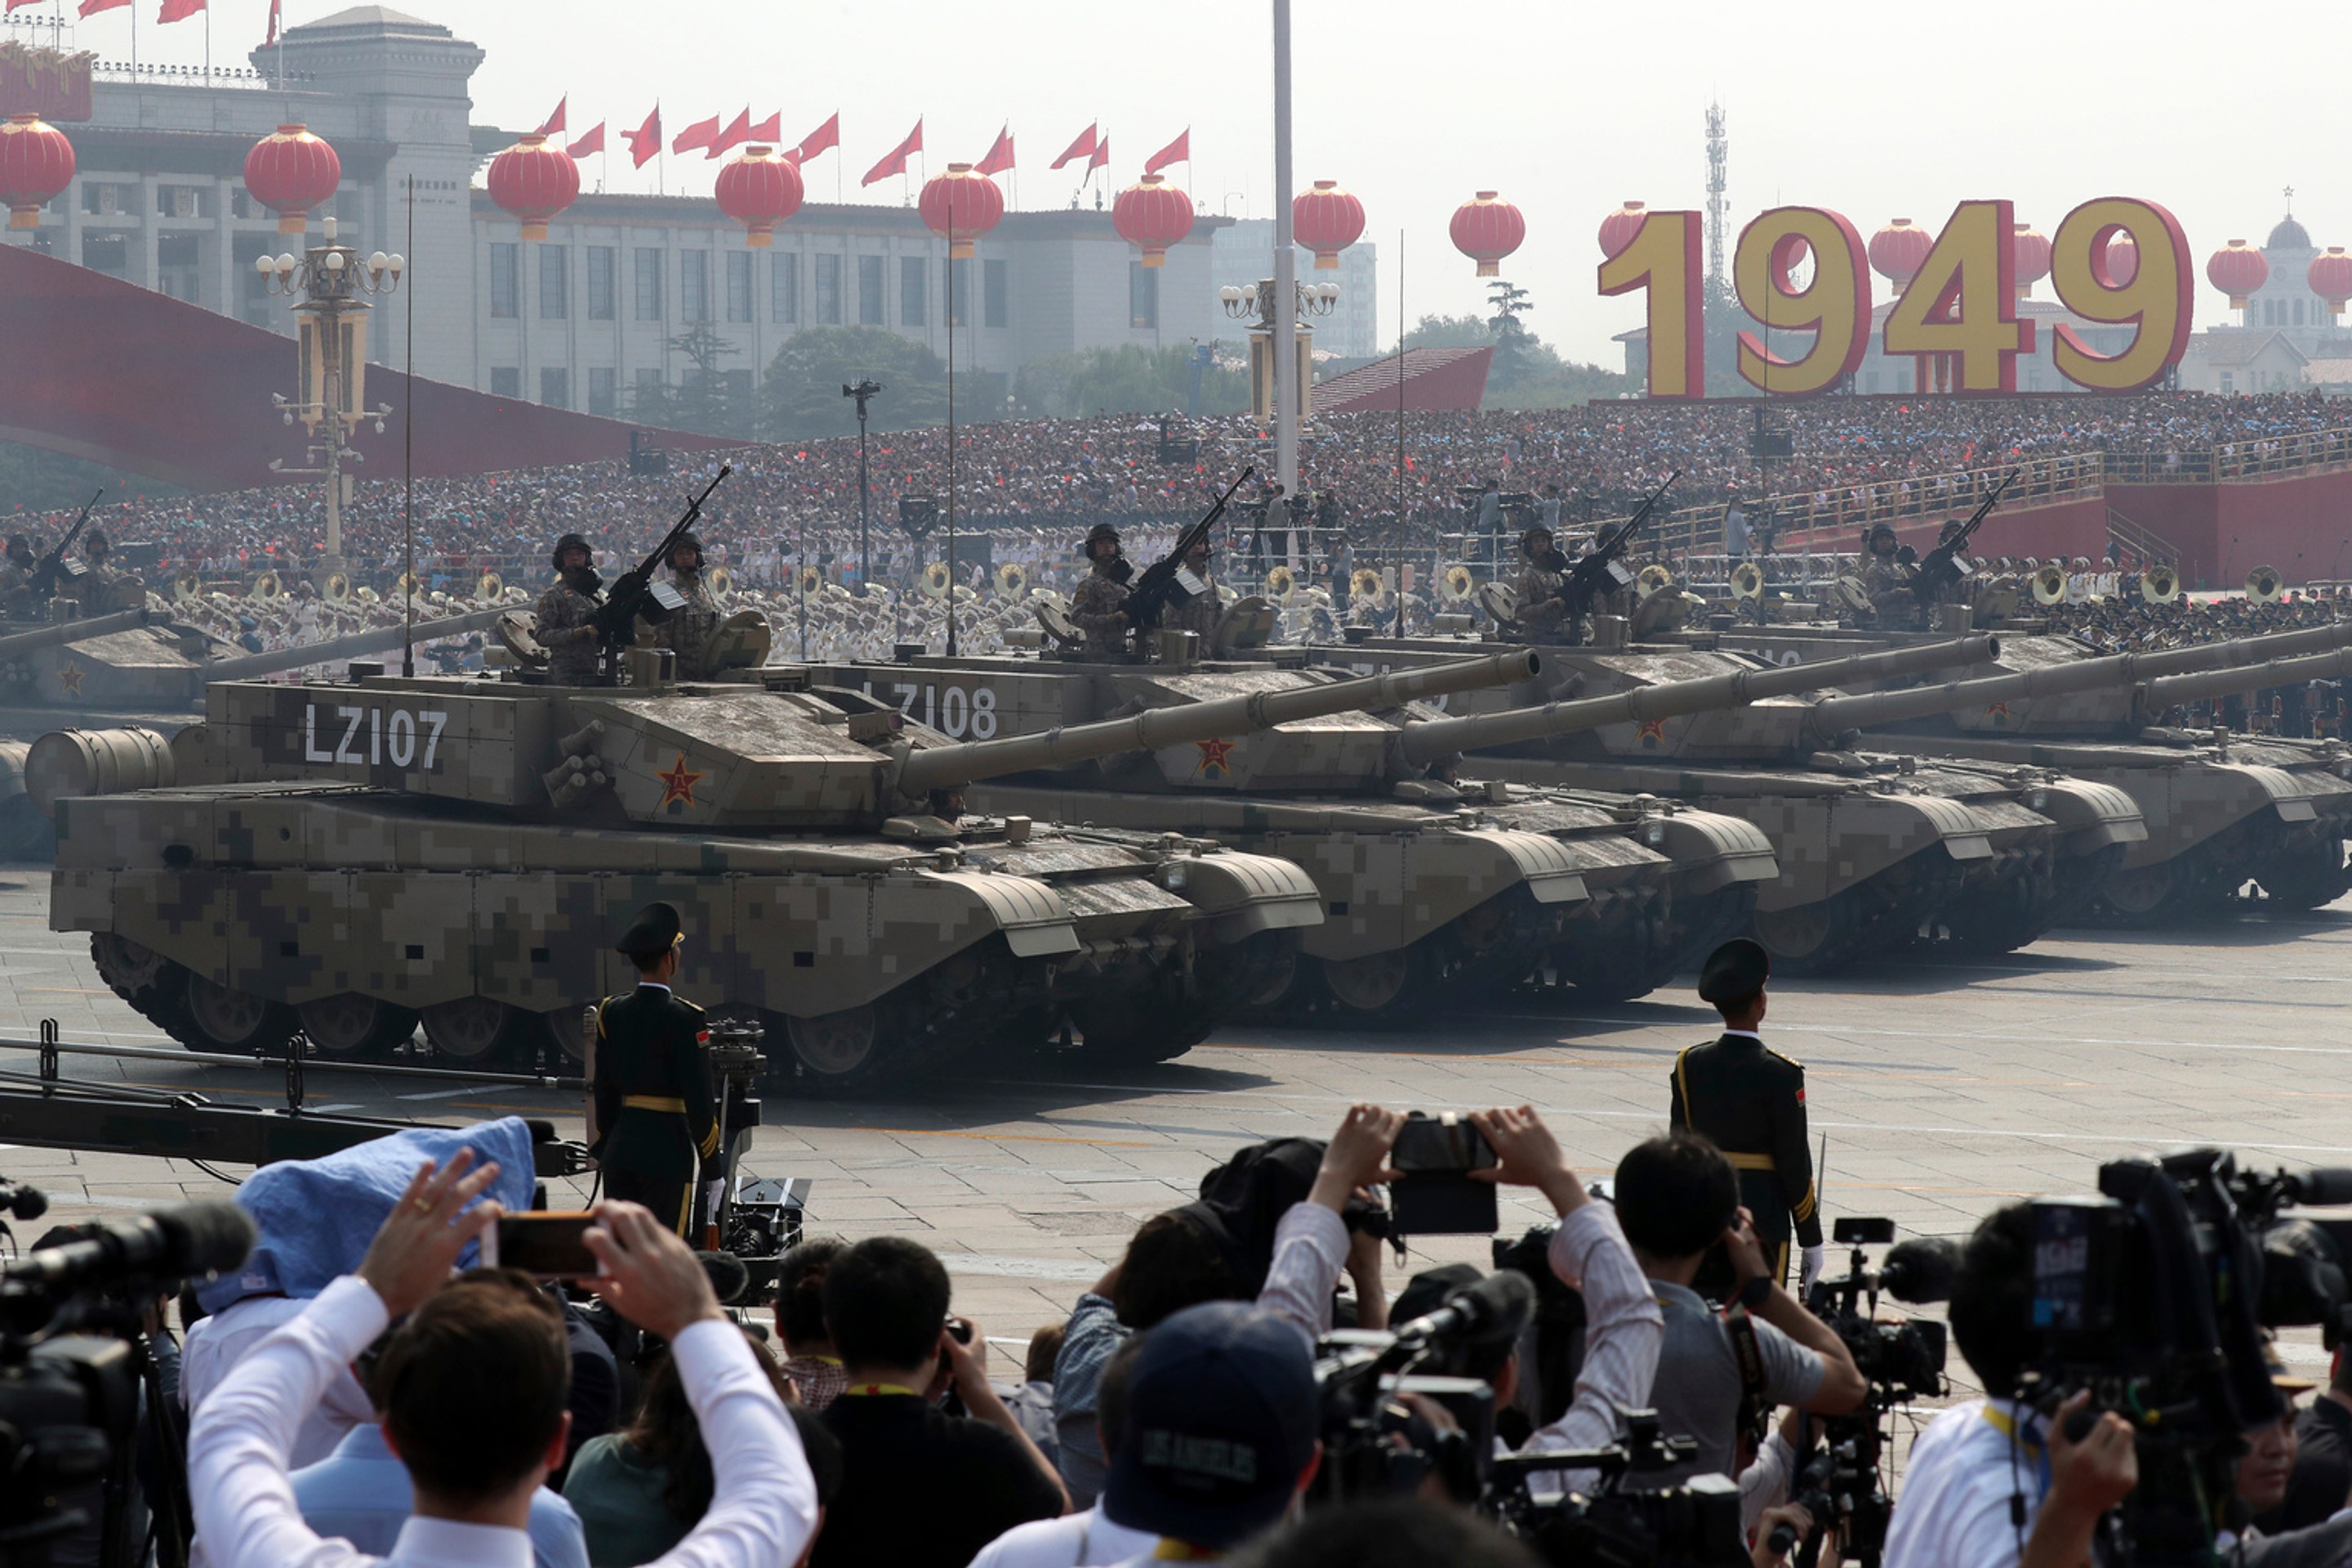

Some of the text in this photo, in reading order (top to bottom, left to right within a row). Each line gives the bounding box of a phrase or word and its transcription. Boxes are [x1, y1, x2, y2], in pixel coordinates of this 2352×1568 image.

[1597, 197, 2194, 399] 1949
[305, 704, 448, 769] LZ107
[862, 681, 997, 739] Z108
